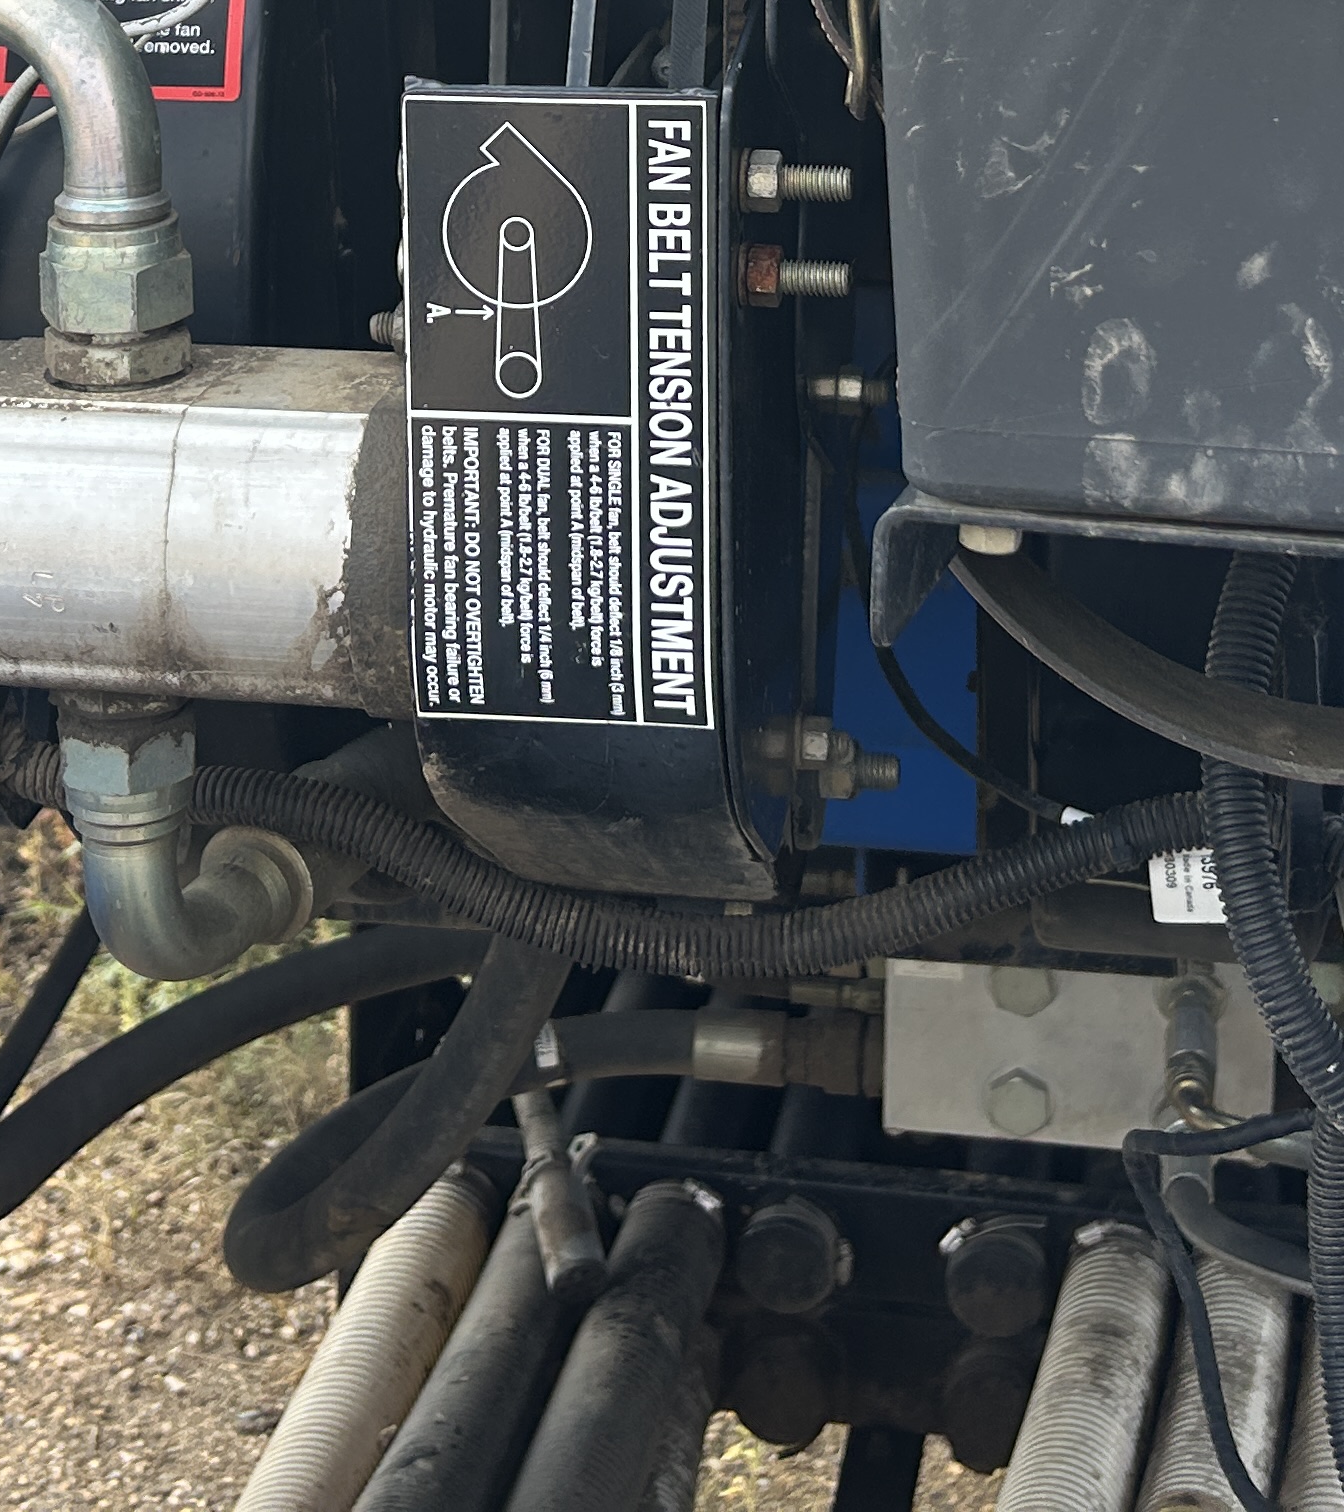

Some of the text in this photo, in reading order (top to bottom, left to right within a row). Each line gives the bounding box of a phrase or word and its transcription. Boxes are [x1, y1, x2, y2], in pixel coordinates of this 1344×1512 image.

[139, 39, 215, 54] emoved.
[175, 22, 201, 37] fan
[426, 302, 451, 324] A.
[647, 119, 697, 716] FAN BELT TENSION ADJUSTMENT
[419, 425, 441, 707] damage to hydraulic motor may occur.
[441, 426, 461, 703] belts. Premature fan bearing failure or
[463, 427, 485, 704] IMPORTANT: DO NOT OVERTIGHTEN
[497, 427, 514, 627] applied at point A (midspan of belt).
[516, 428, 533, 663] when a 4-6 lb/belt (1.8-2.7 kg/belt) force is
[535, 429, 554, 703] FOR DUAL fan, belt should deflect 1/4 inch (6 mm)
[567, 430, 585, 630] applied at point A (midspan of belt).
[586, 430, 604, 667] when a 4-6 lb/belt (1.8-2.7 kg/belt) force is
[606, 431, 625, 715] FOR SINGLE fan, belt should deflect 1/8 inch (3 mm)
